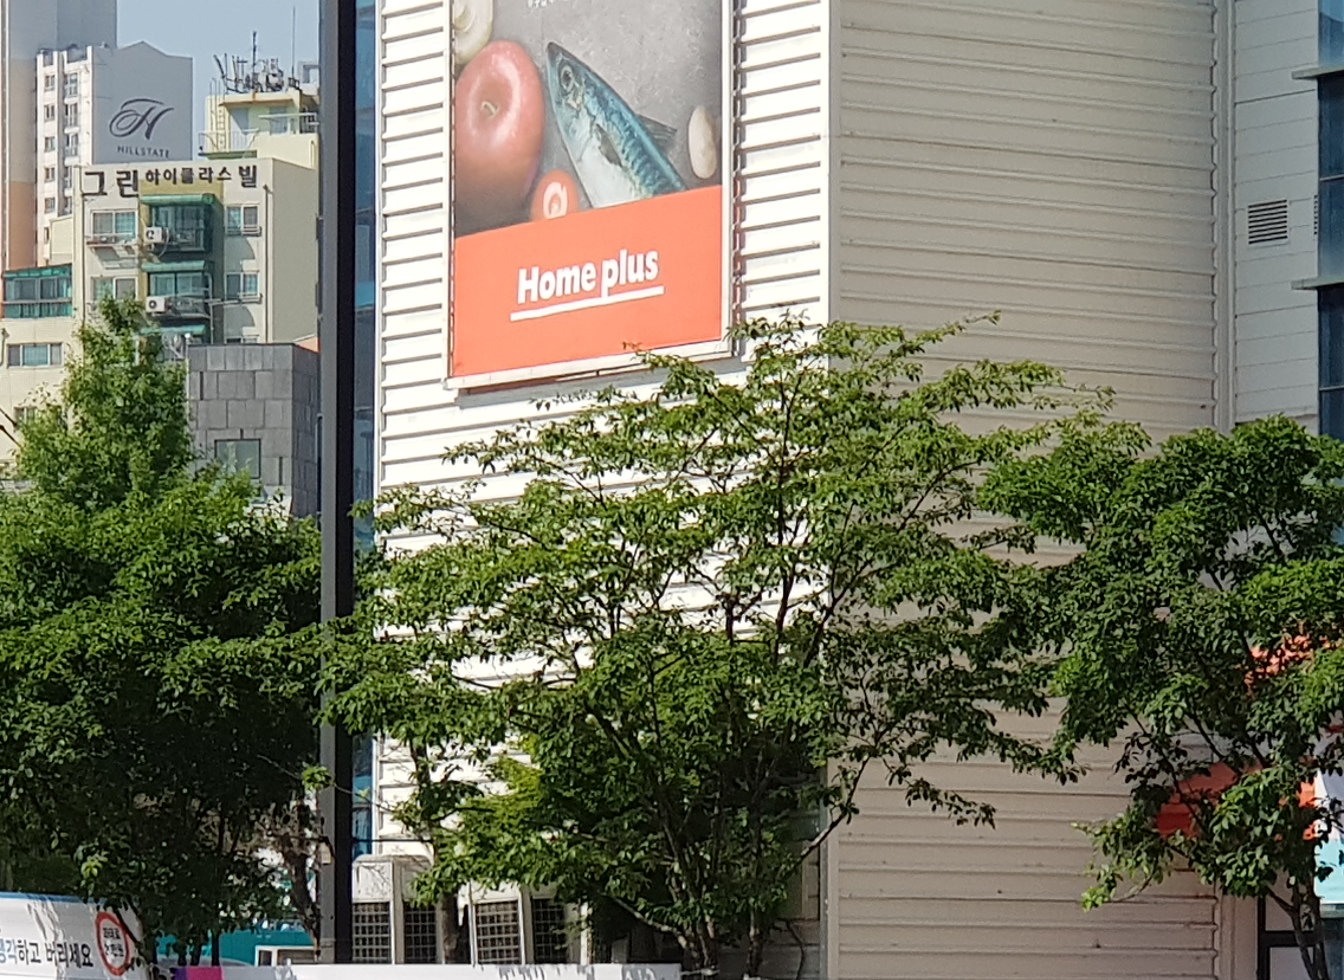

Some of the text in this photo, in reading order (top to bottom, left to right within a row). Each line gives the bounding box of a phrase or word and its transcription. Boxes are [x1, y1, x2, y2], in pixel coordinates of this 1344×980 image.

[116, 144, 170, 160] HILLSTATE
[82, 169, 139, 198] 그린
[238, 164, 258, 188] 빌
[517, 248, 660, 304] Home plus
[44, 939, 95, 969] 버리세요
